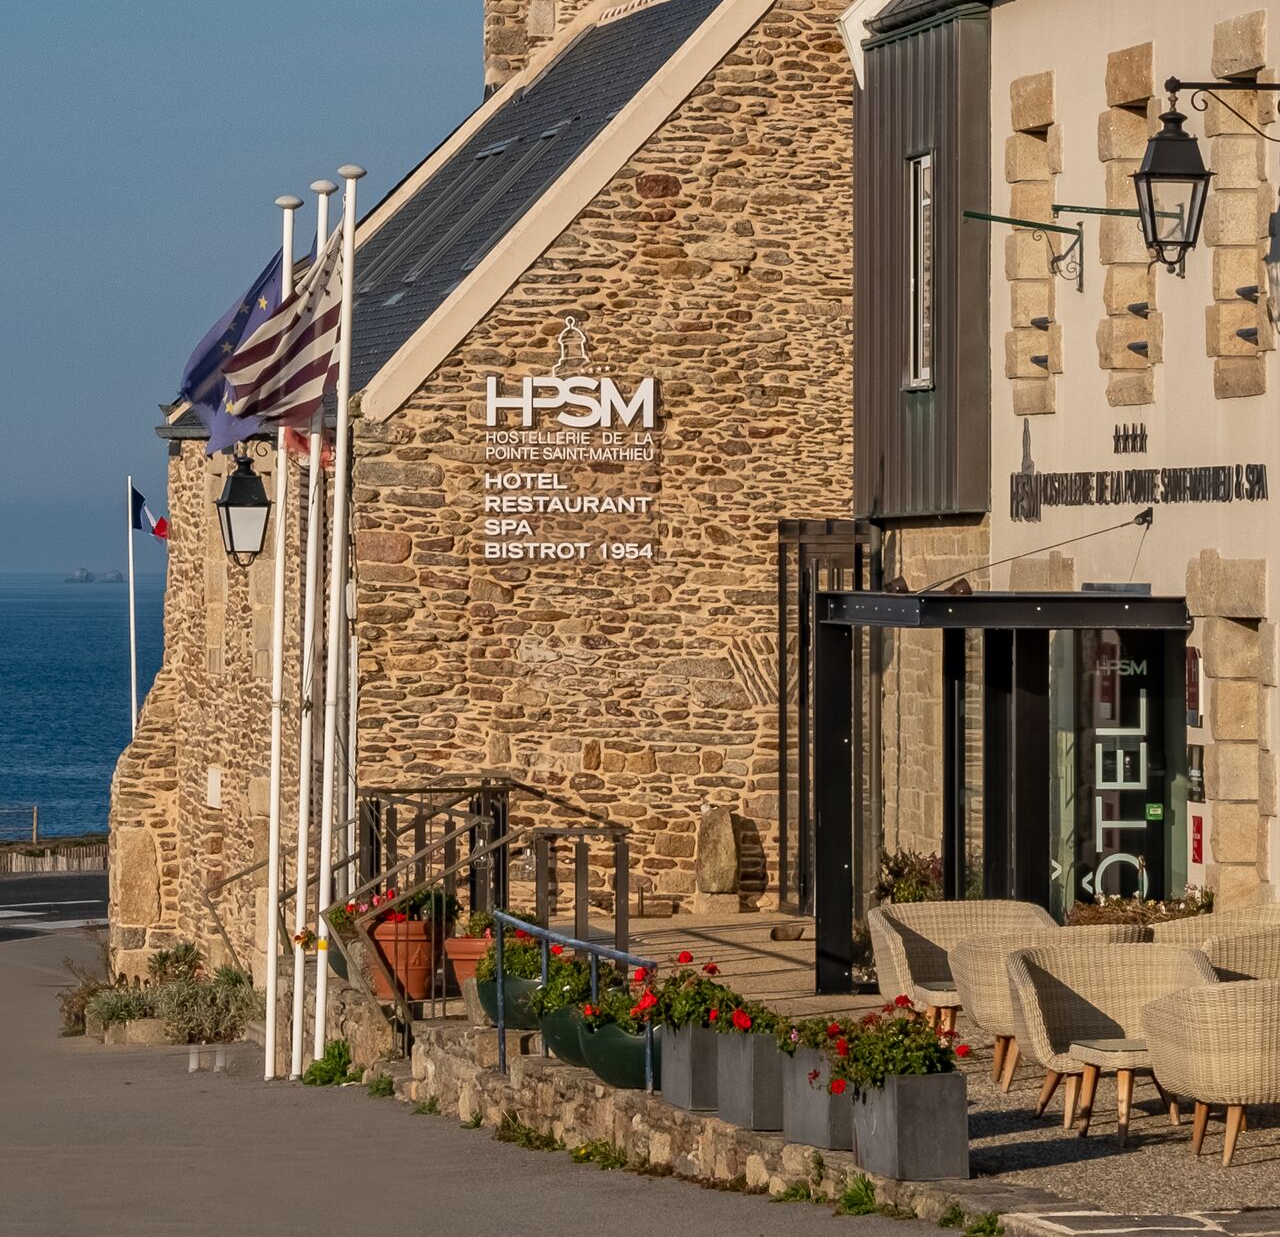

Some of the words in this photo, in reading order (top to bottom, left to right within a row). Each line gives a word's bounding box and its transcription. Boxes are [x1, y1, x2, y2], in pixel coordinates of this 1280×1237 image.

[486, 376, 654, 428] HPSM
[485, 431, 590, 445] HOSTELLERIE
[602, 432, 623, 445] DE
[634, 432, 654, 445] LA
[485, 447, 539, 460] POINTE
[542, 447, 654, 461] SAINT-MATHIEU
[484, 473, 567, 490] HOTEL
[1245, 463, 1268, 502] SPA
[484, 496, 652, 513] RESTAURANT
[484, 519, 534, 536] SPA
[484, 542, 591, 559] BISTROT
[599, 543, 653, 559] 1954
[1095, 659, 1147, 676] HPSM
